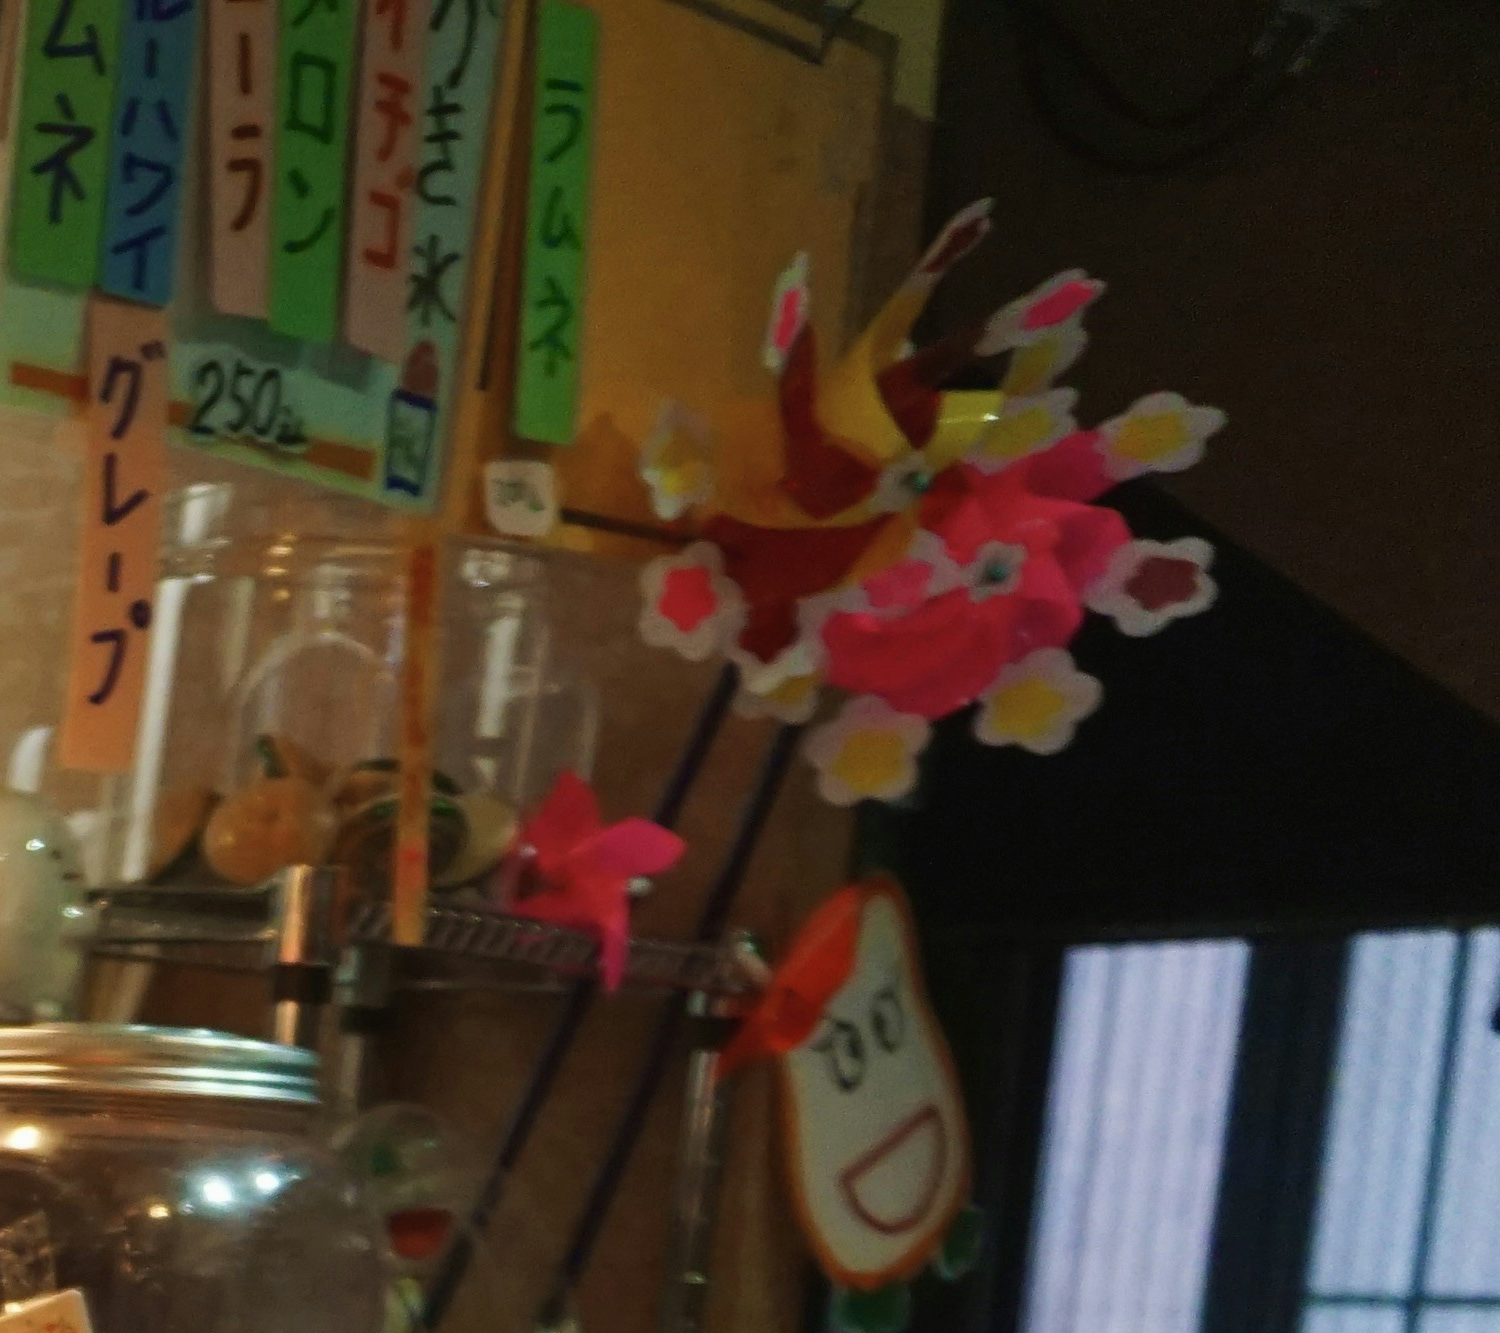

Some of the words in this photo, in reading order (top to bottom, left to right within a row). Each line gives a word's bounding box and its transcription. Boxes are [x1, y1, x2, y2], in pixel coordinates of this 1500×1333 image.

[529, 79, 583, 378] ラムネ
[88, 339, 168, 706] グレープ
